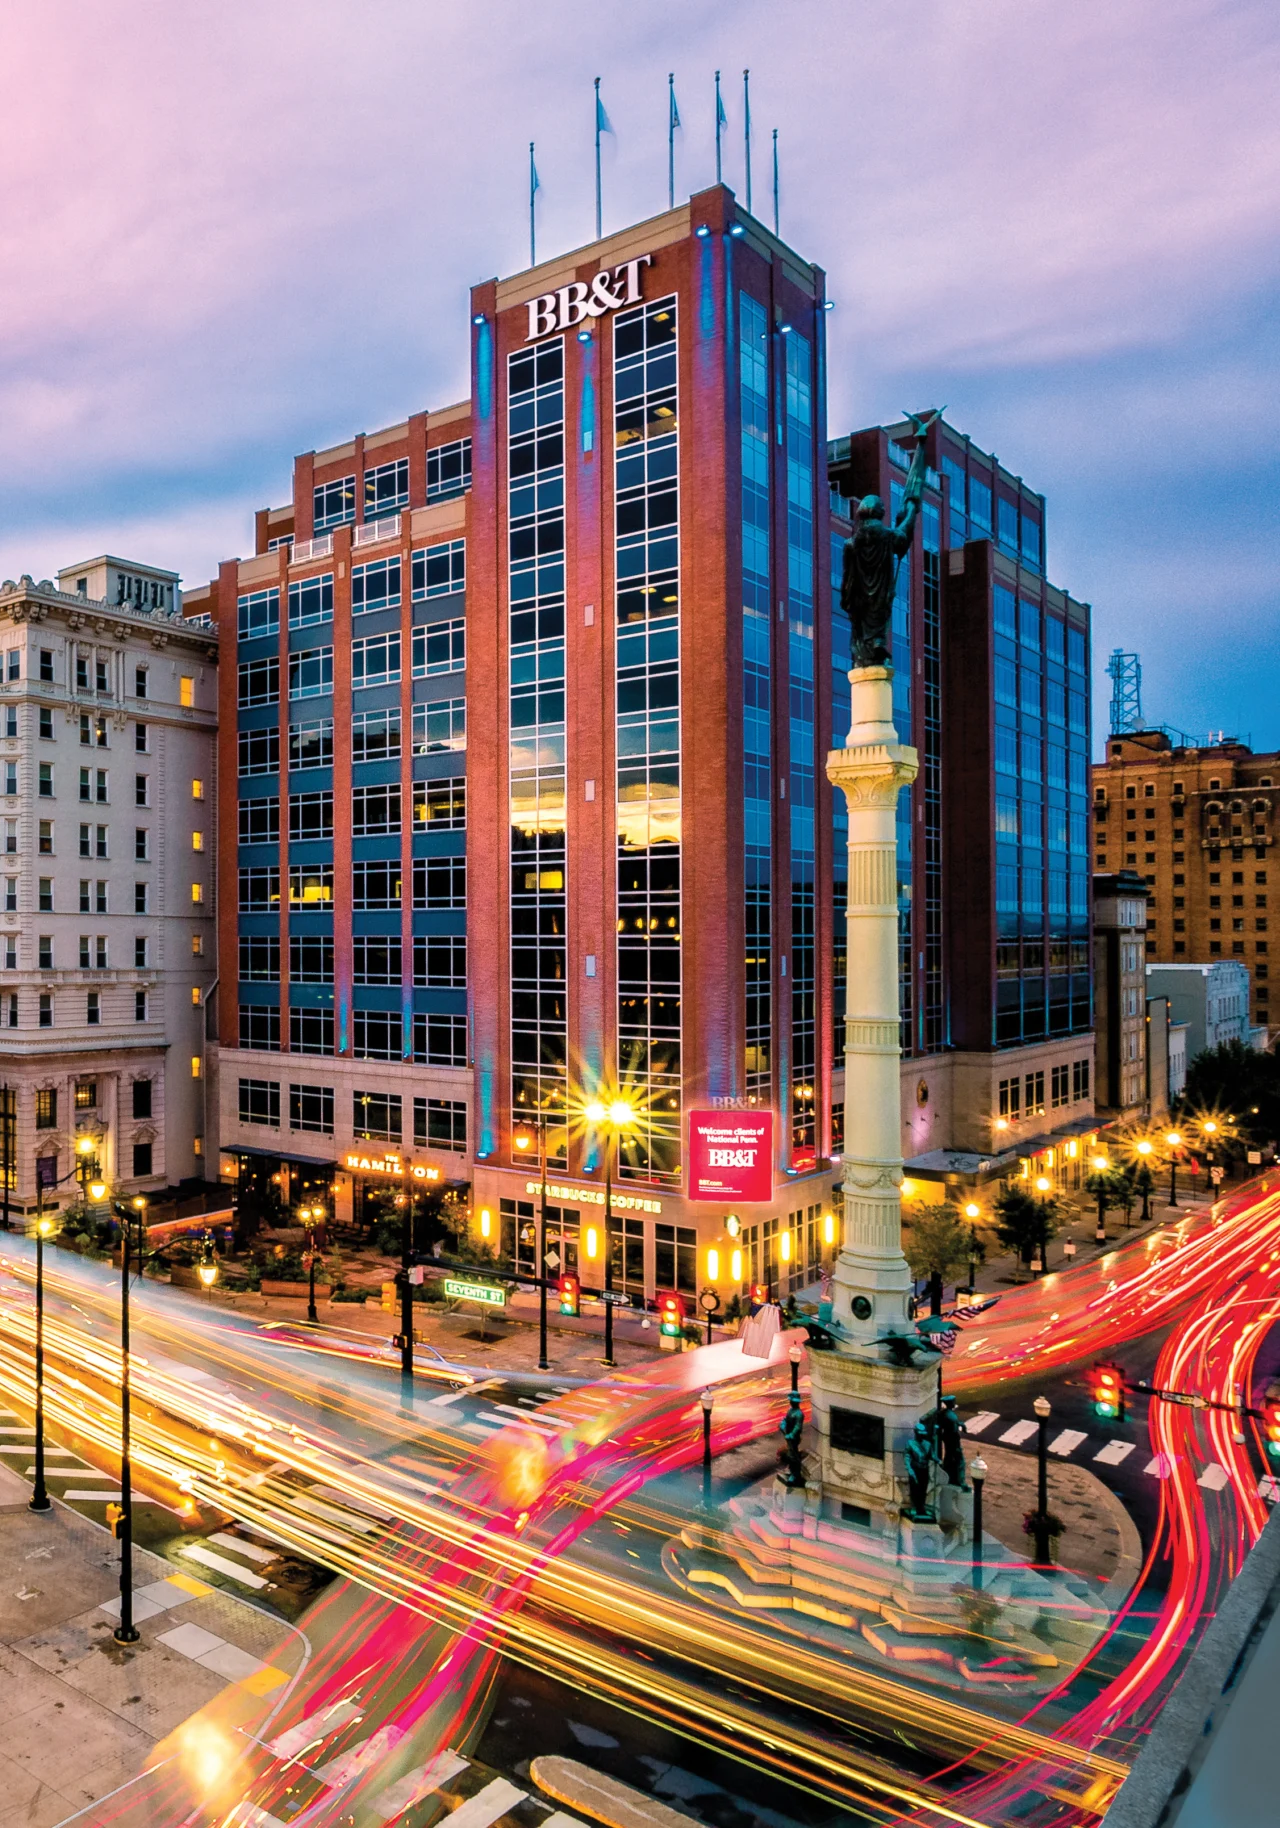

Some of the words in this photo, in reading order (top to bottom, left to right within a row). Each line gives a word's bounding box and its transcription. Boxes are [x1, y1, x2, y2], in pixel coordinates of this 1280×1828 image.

[524, 254, 651, 341] BB&T
[698, 1127, 732, 1135] Welcome
[734, 1127, 756, 1136] clients
[757, 1127, 764, 1135] of
[707, 1136, 739, 1144] National
[347, 1156, 439, 1180] HAMILON
[708, 1149, 757, 1168] BB&T
[526, 1182, 605, 1205] STARBUCKS
[610, 1195, 662, 1214] COFFEE
[447, 1283, 487, 1299] SEVENTH
[490, 1292, 502, 1302] ST
